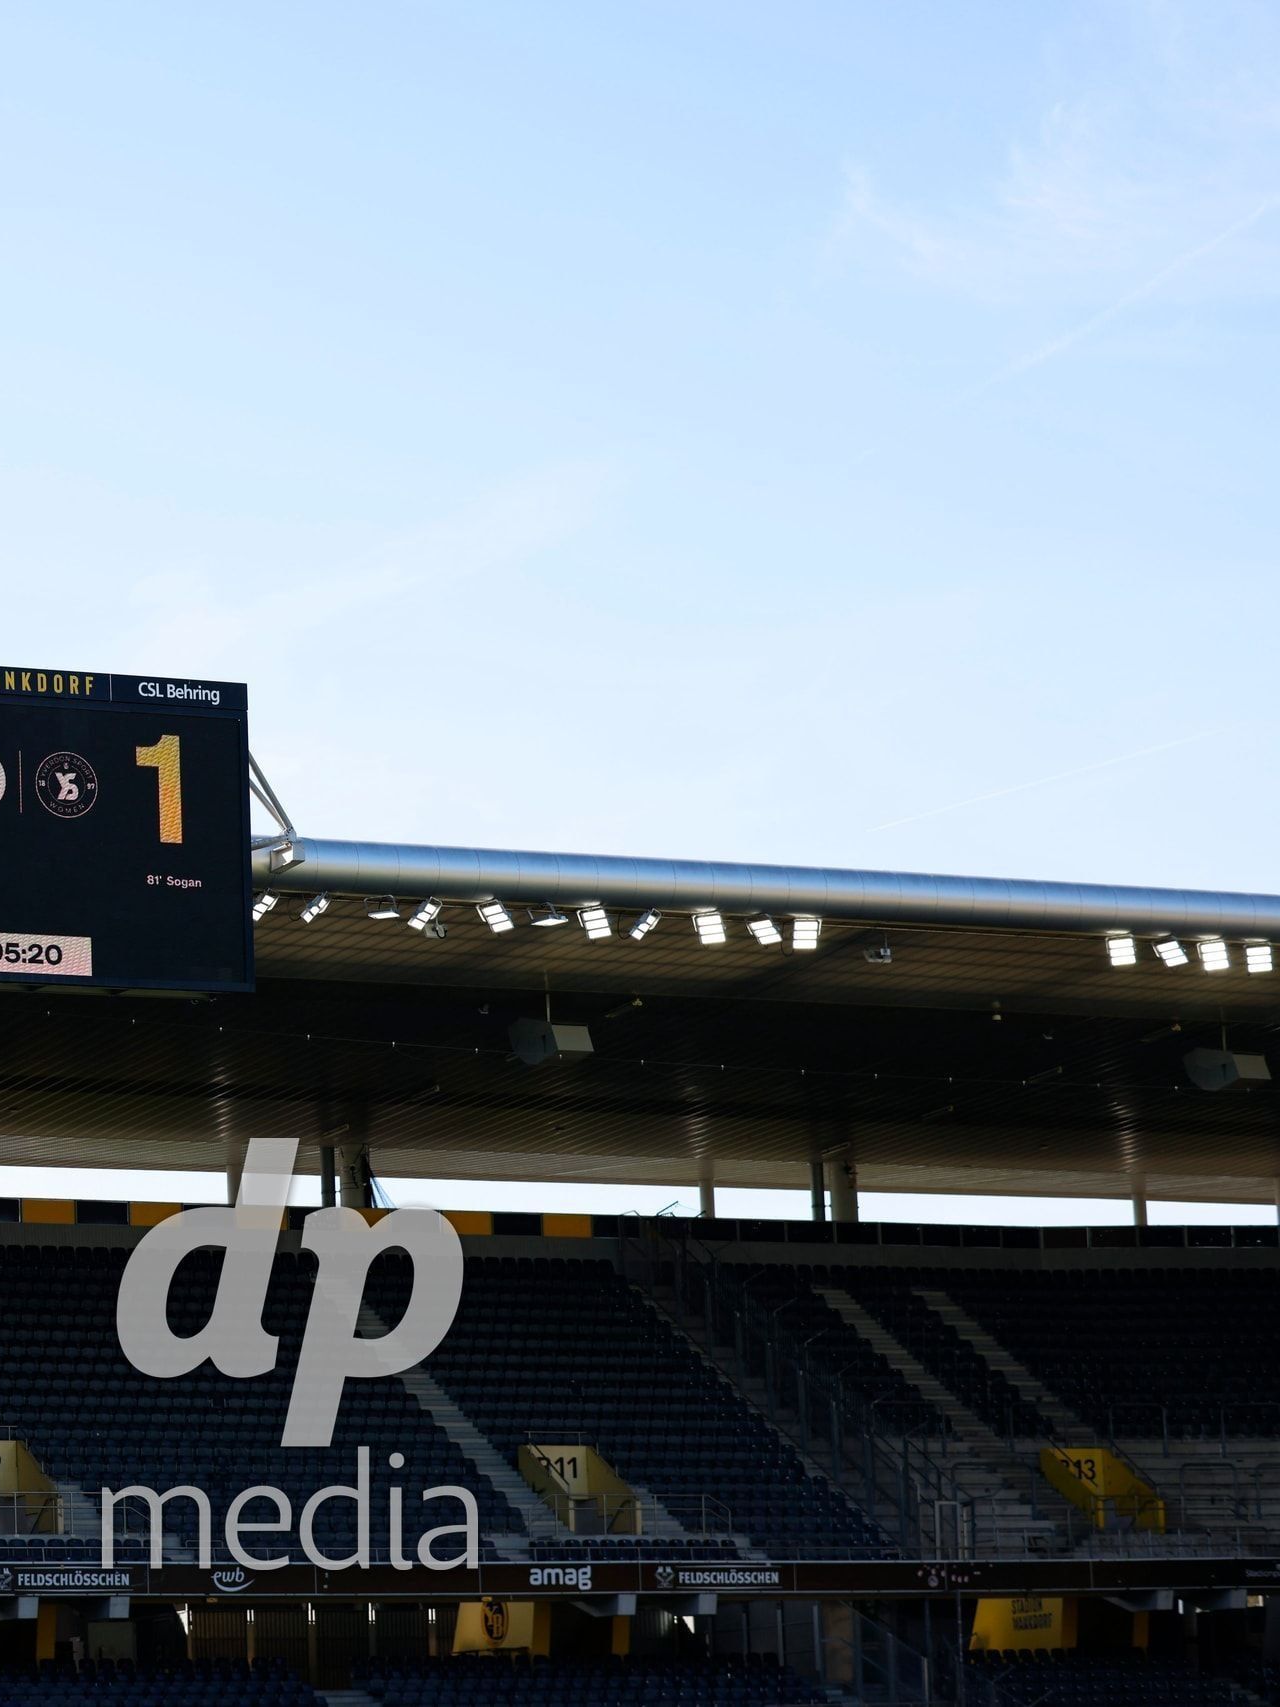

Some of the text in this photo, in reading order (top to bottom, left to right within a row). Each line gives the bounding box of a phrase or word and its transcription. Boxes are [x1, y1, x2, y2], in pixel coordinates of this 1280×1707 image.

[138, 682, 220, 705] CSL Behring
[136, 734, 183, 844] 1
[146, 874, 202, 889] 81' Sogan
[1060, 1459, 1096, 1480] 13
[17, 1570, 130, 1586] FELDSCHLÖSSCHEN
[212, 1567, 246, 1583] ewb
[529, 1564, 592, 1591] amag
[678, 1568, 780, 1585] FELDSCHLÖSSCHEN
